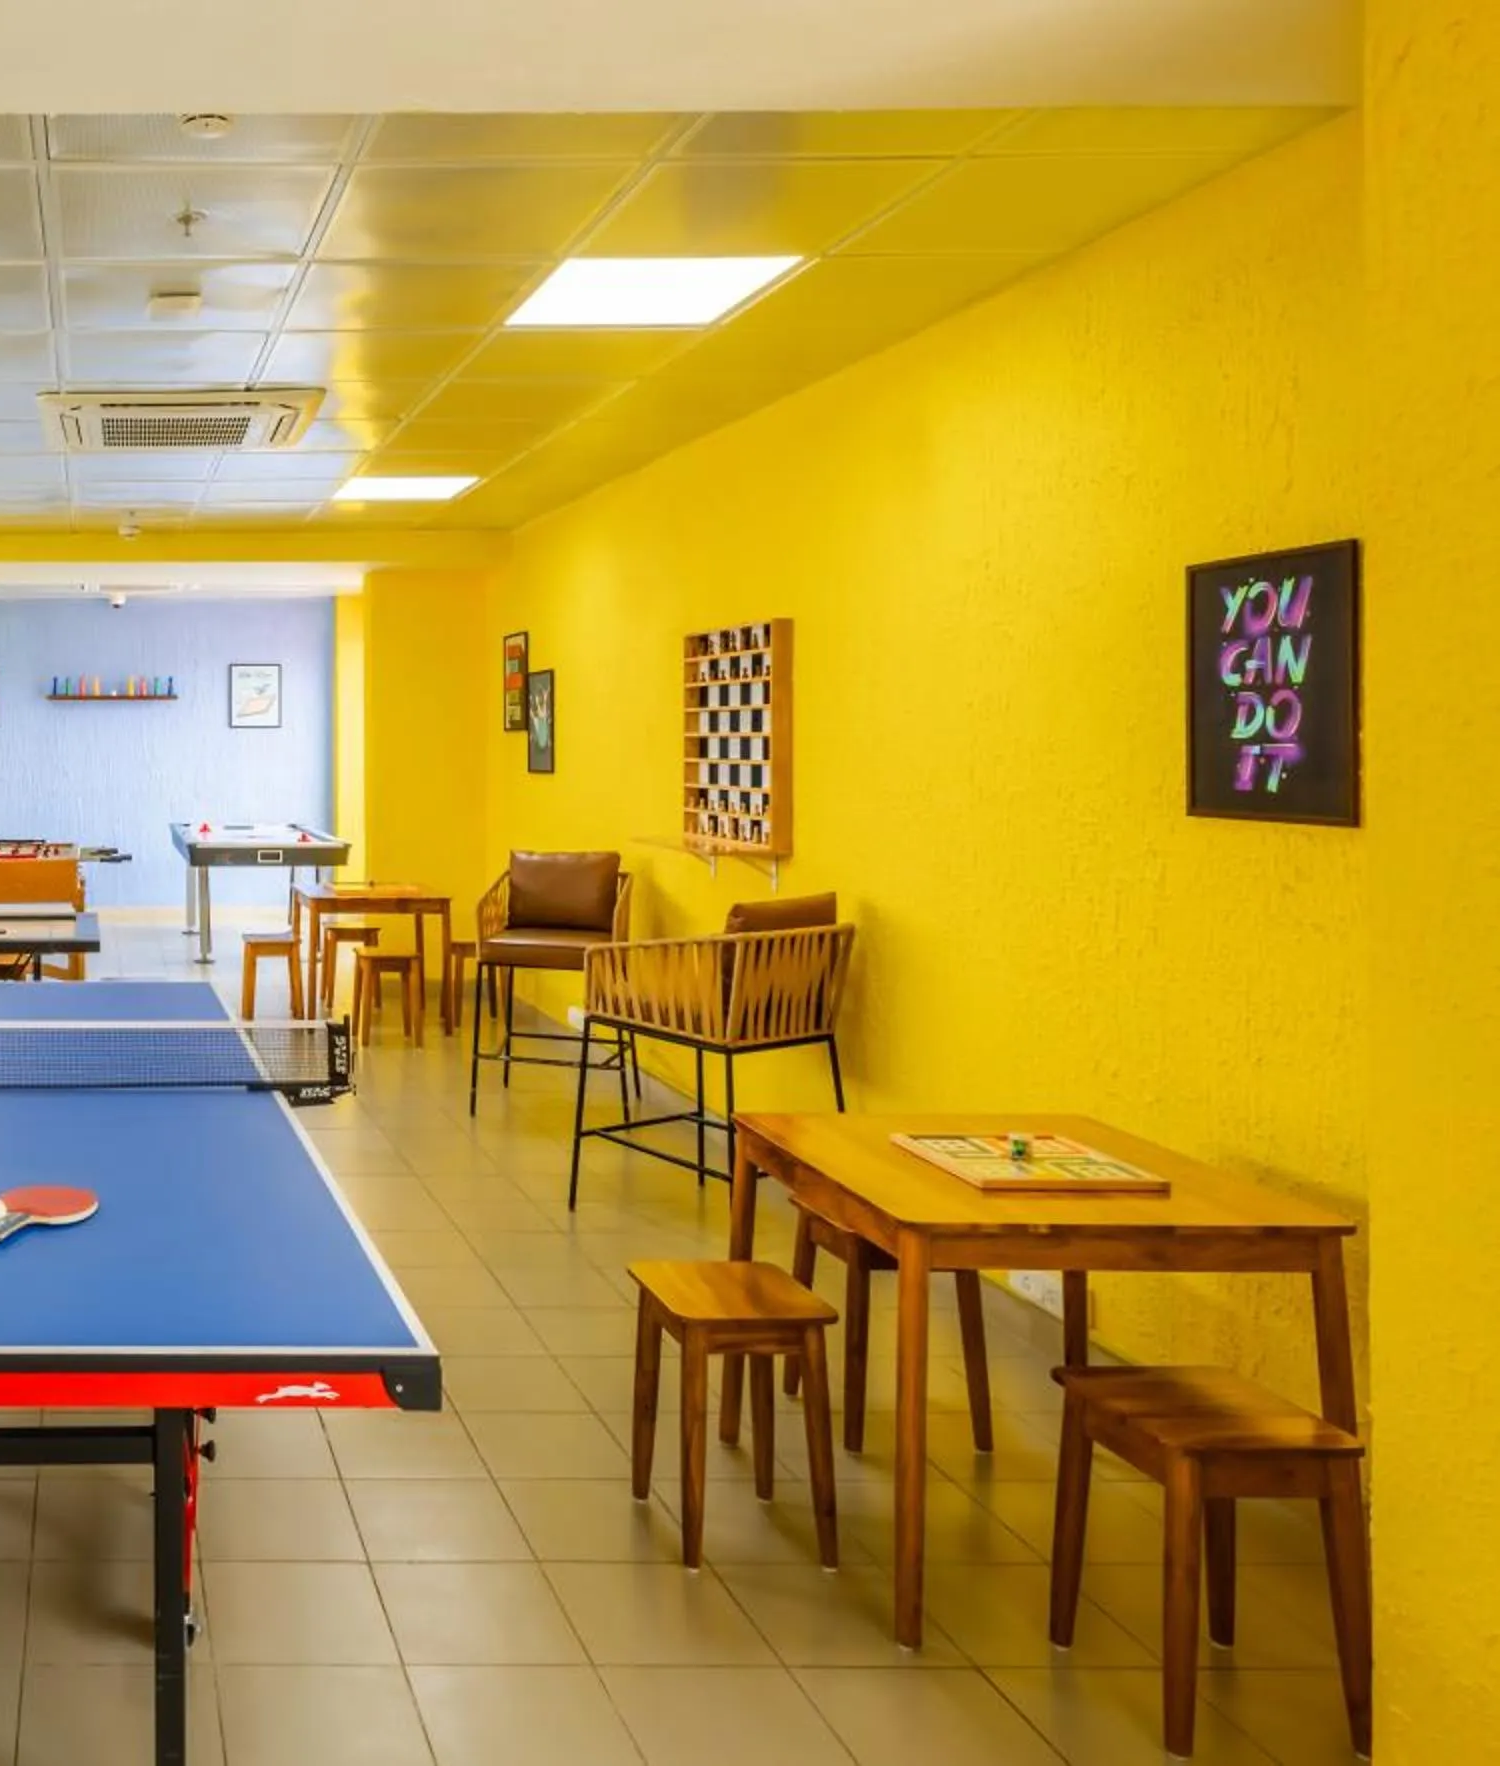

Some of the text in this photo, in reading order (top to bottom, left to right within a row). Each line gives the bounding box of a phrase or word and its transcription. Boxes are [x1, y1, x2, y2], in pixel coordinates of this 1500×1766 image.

[1220, 576, 1313, 634] YOU
[1219, 634, 1312, 686] CAN
[1230, 688, 1302, 739] DO
[1234, 742, 1303, 793] IT
